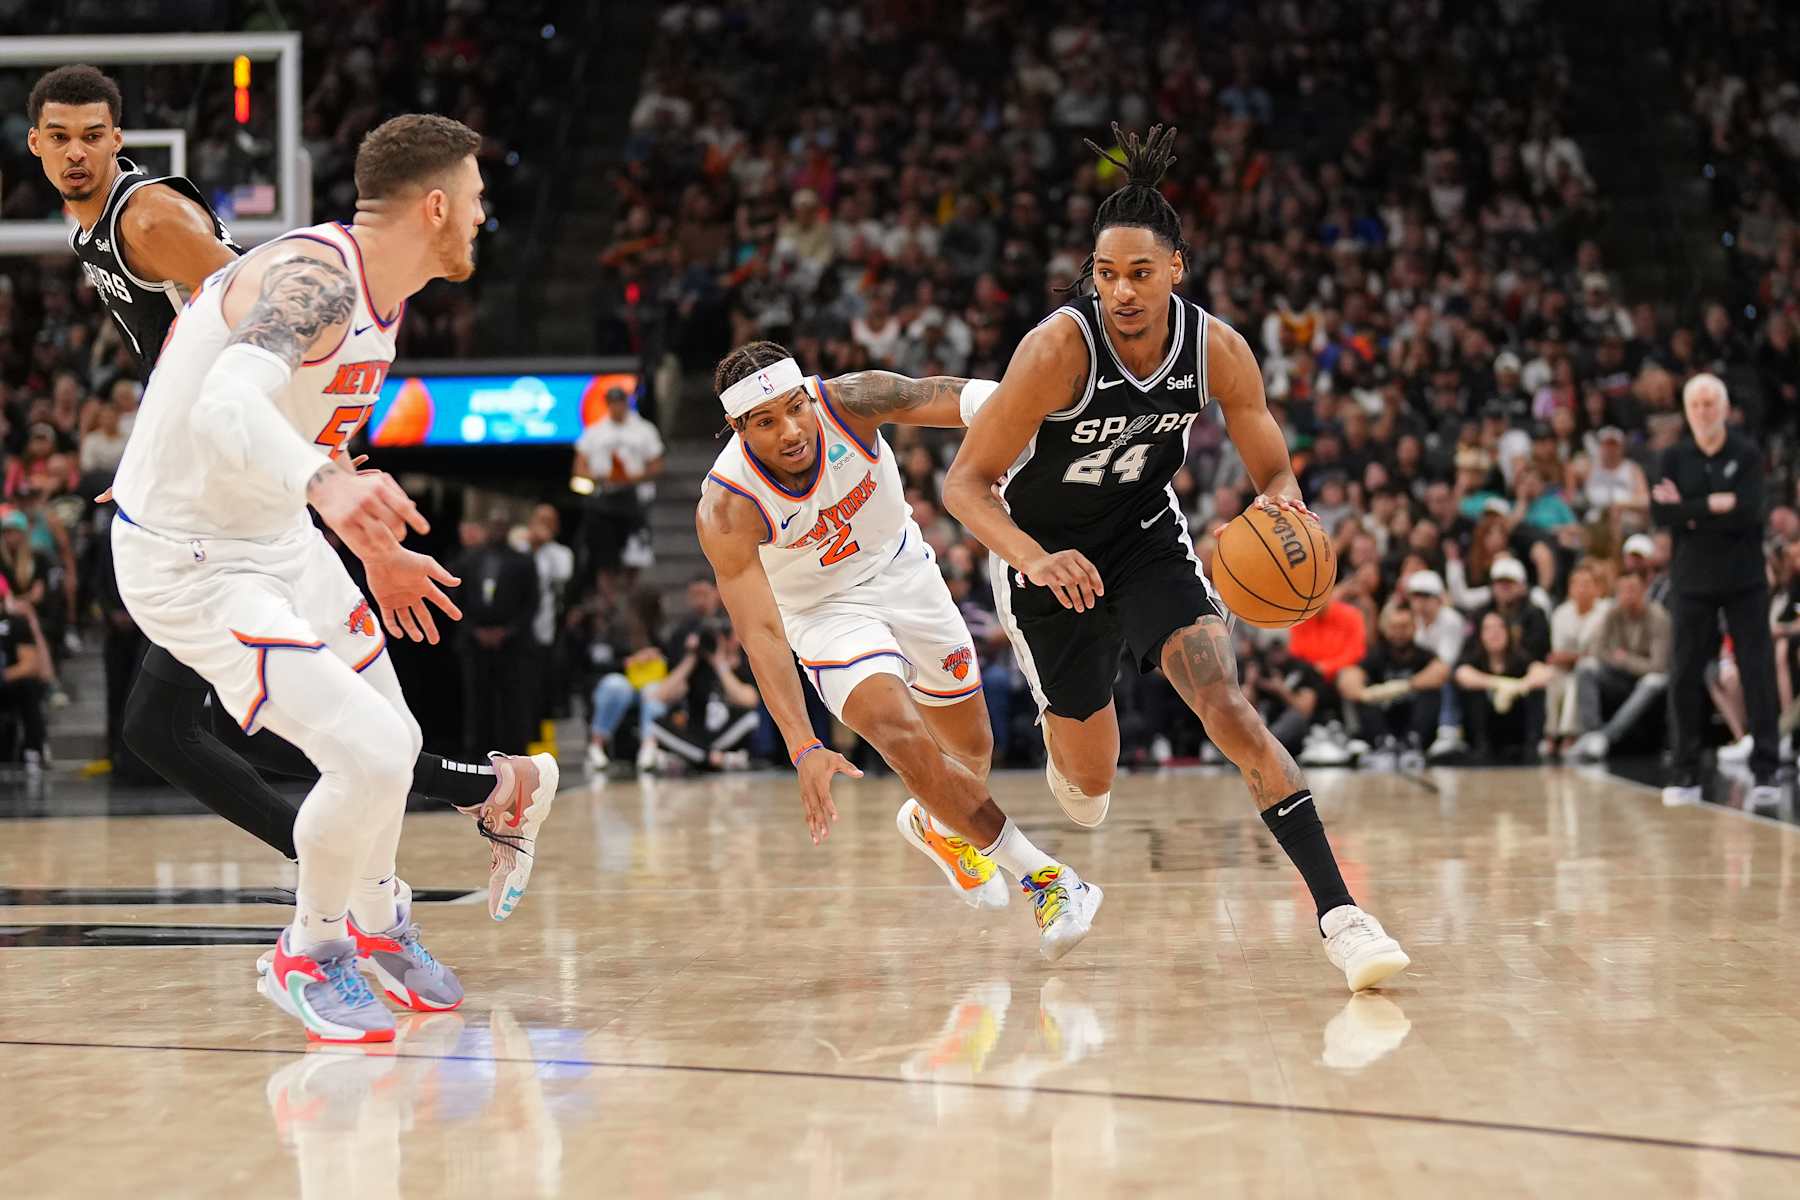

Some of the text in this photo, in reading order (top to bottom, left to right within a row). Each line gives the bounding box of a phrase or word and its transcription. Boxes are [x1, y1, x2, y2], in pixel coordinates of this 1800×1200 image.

[1166, 374, 1196, 391] Self.
[832, 452, 856, 472] sphere
[1062, 444, 1154, 486] 24
[820, 470, 878, 531] YORK
[817, 522, 860, 567] 2
